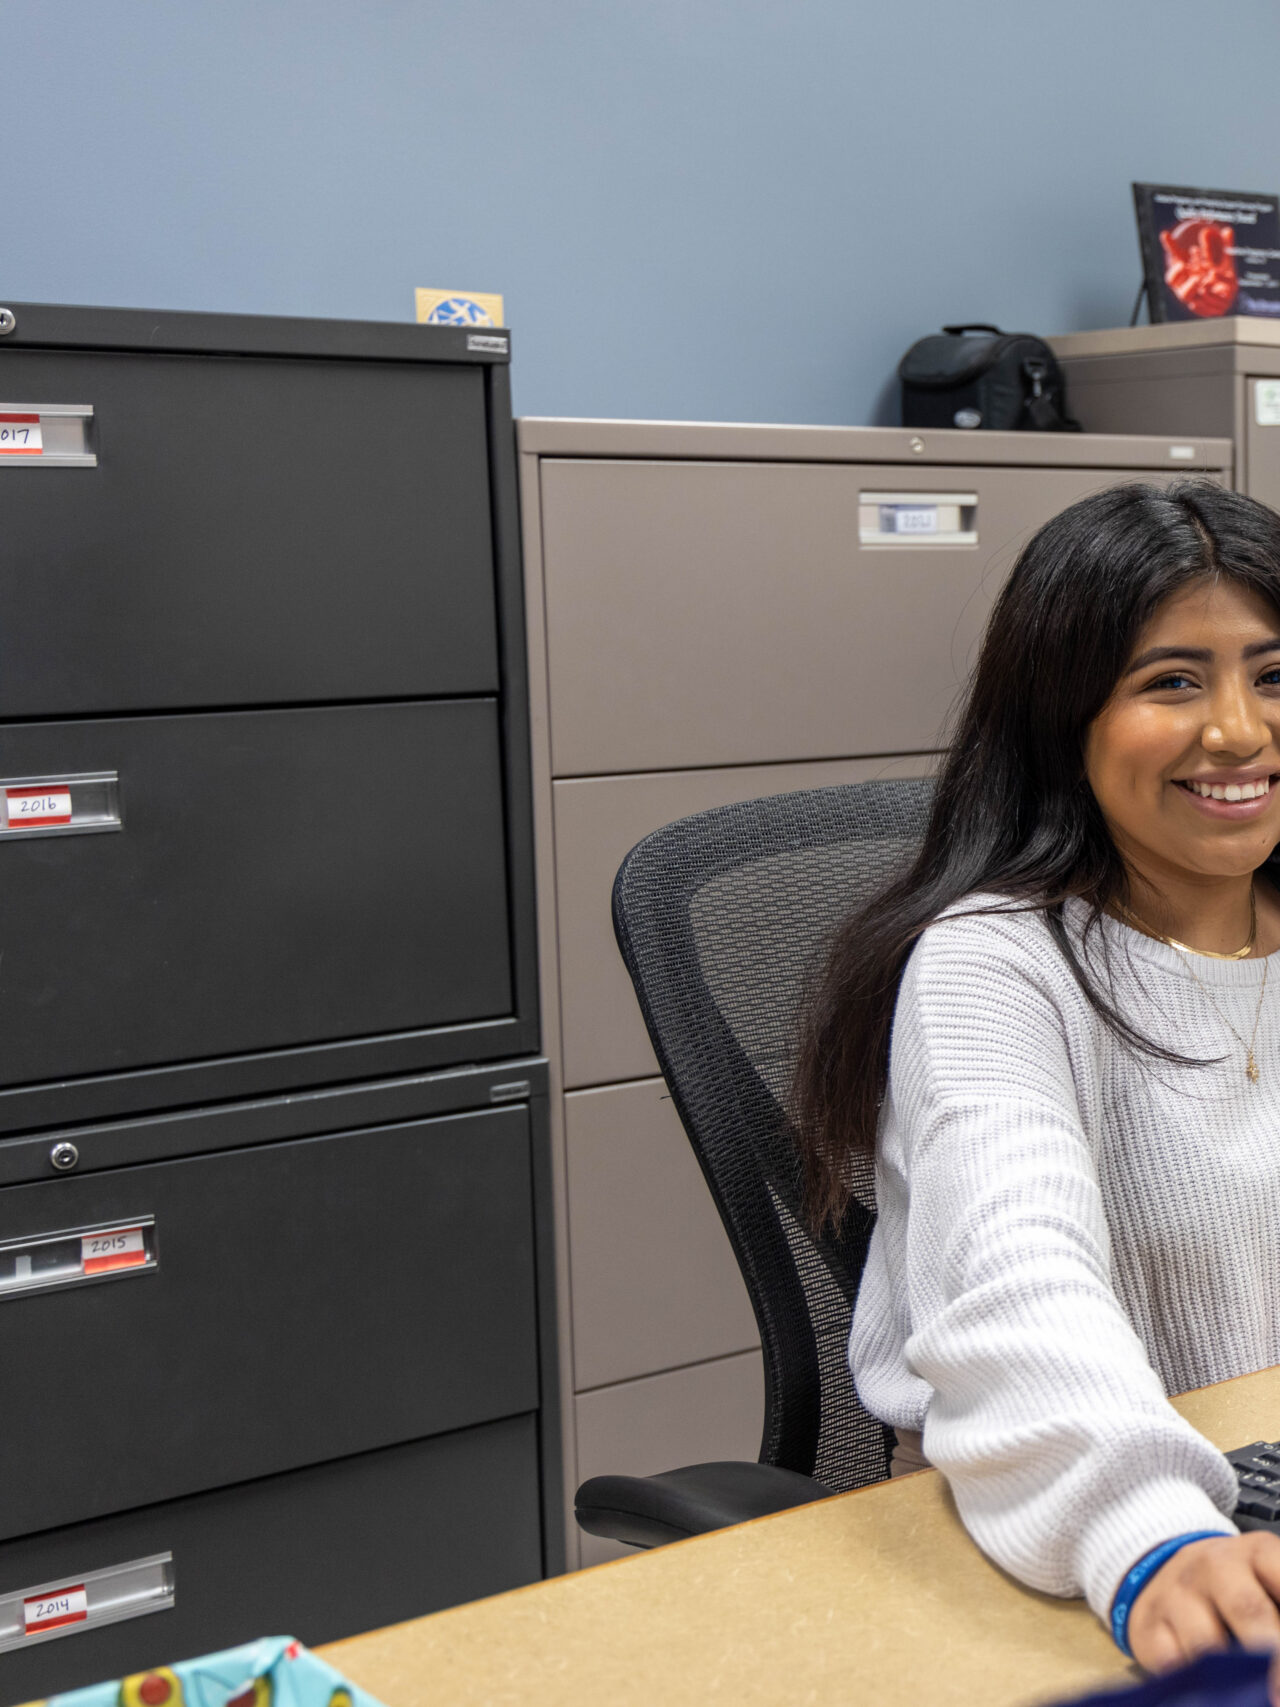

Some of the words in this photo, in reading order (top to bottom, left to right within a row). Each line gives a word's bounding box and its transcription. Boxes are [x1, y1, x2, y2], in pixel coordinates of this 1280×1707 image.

[20, 796, 57, 813] 2016
[91, 1235, 128, 1253] 2015
[35, 1598, 70, 1618] 2014
